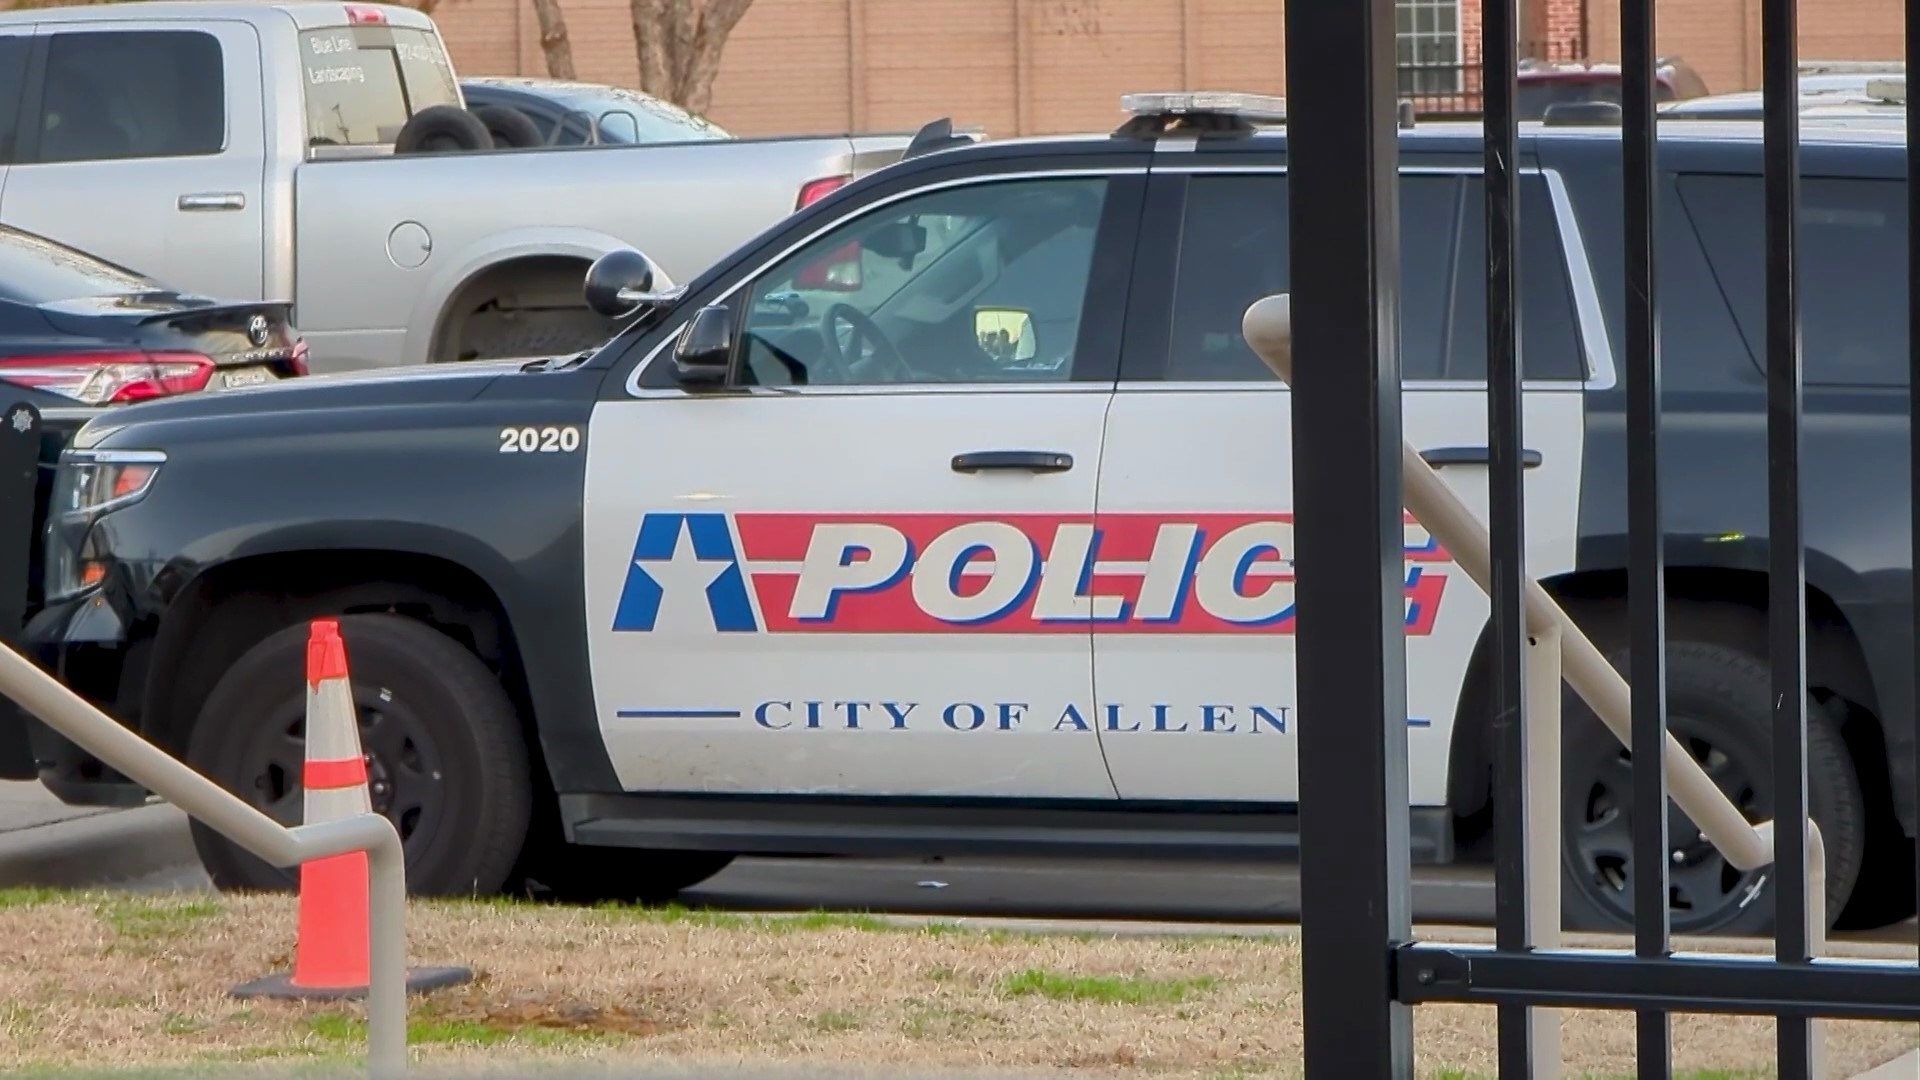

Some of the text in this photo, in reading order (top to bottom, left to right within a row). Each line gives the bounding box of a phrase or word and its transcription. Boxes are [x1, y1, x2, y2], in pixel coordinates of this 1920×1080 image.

[310, 36, 352, 54] Blue Line
[308, 66, 365, 83] Landscaping
[499, 427, 580, 453] 2020
[754, 700, 1290, 734] CITY OF ALLEN
